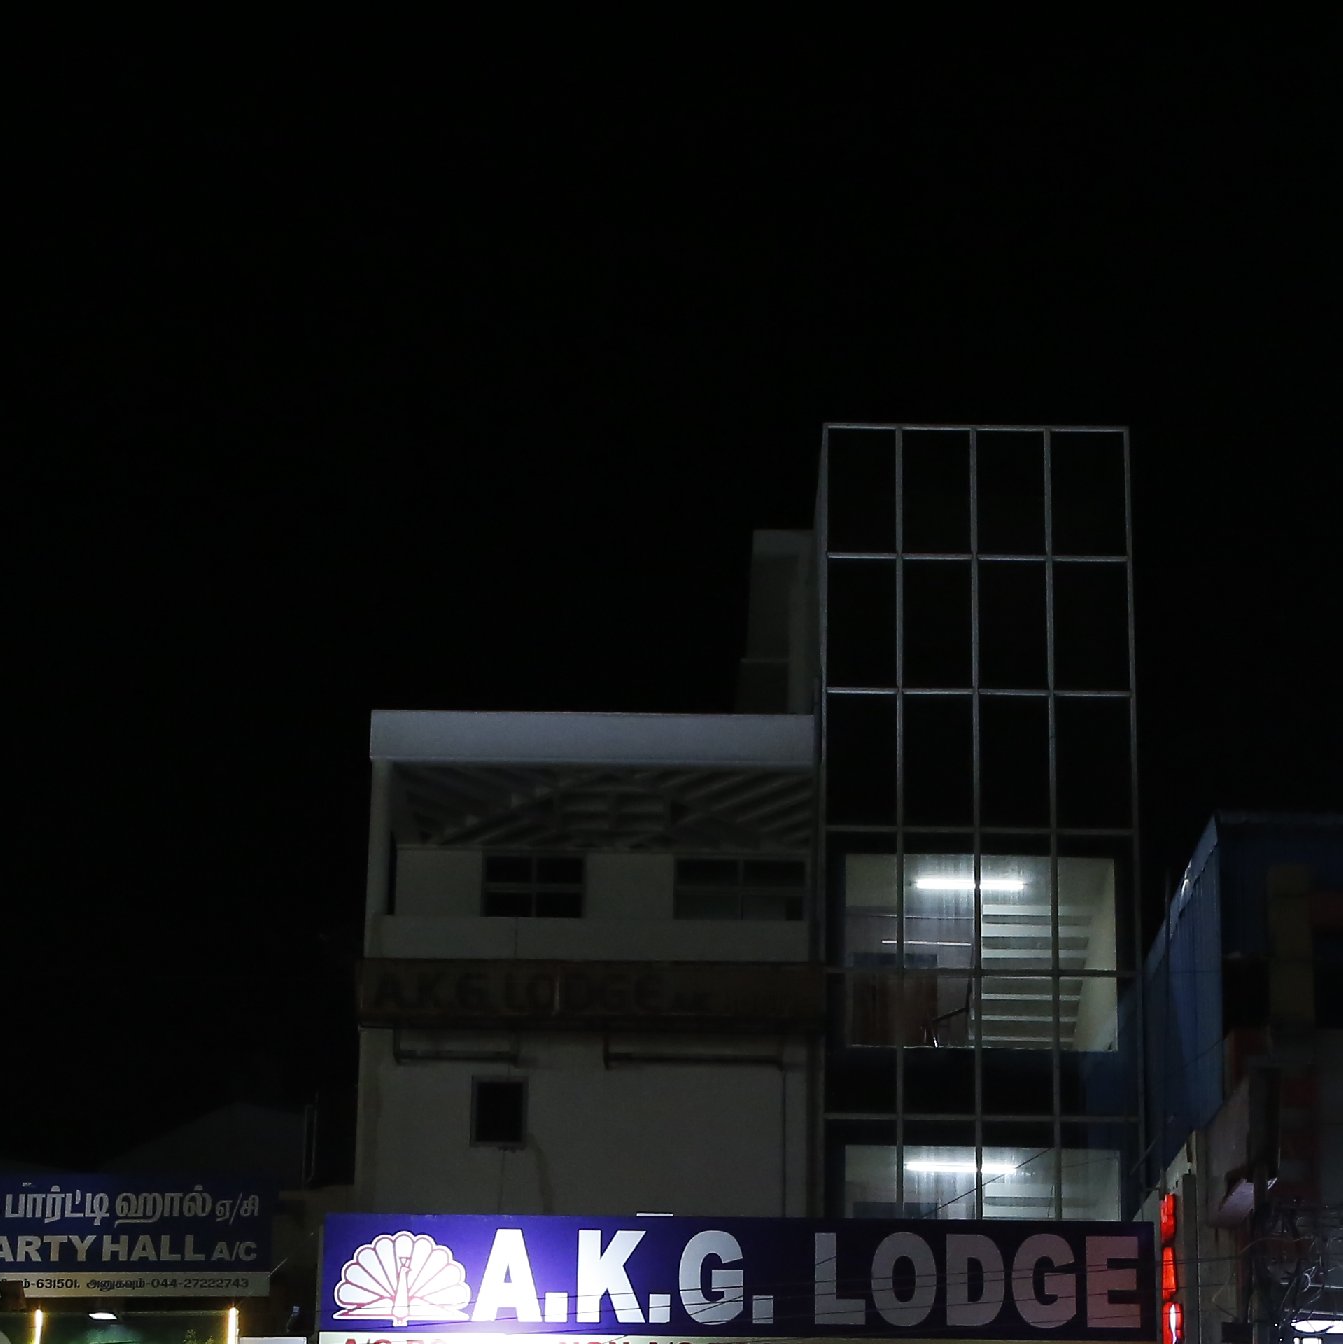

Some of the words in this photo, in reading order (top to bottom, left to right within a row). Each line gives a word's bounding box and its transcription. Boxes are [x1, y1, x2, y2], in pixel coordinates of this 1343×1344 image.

[115, 1184, 212, 1228] ஹால்
[102, 1234, 205, 1262] HALL
[210, 1241, 257, 1261] A/C
[472, 1227, 774, 1327] A.K.G.
[812, 1230, 1145, 1330] LODGE
